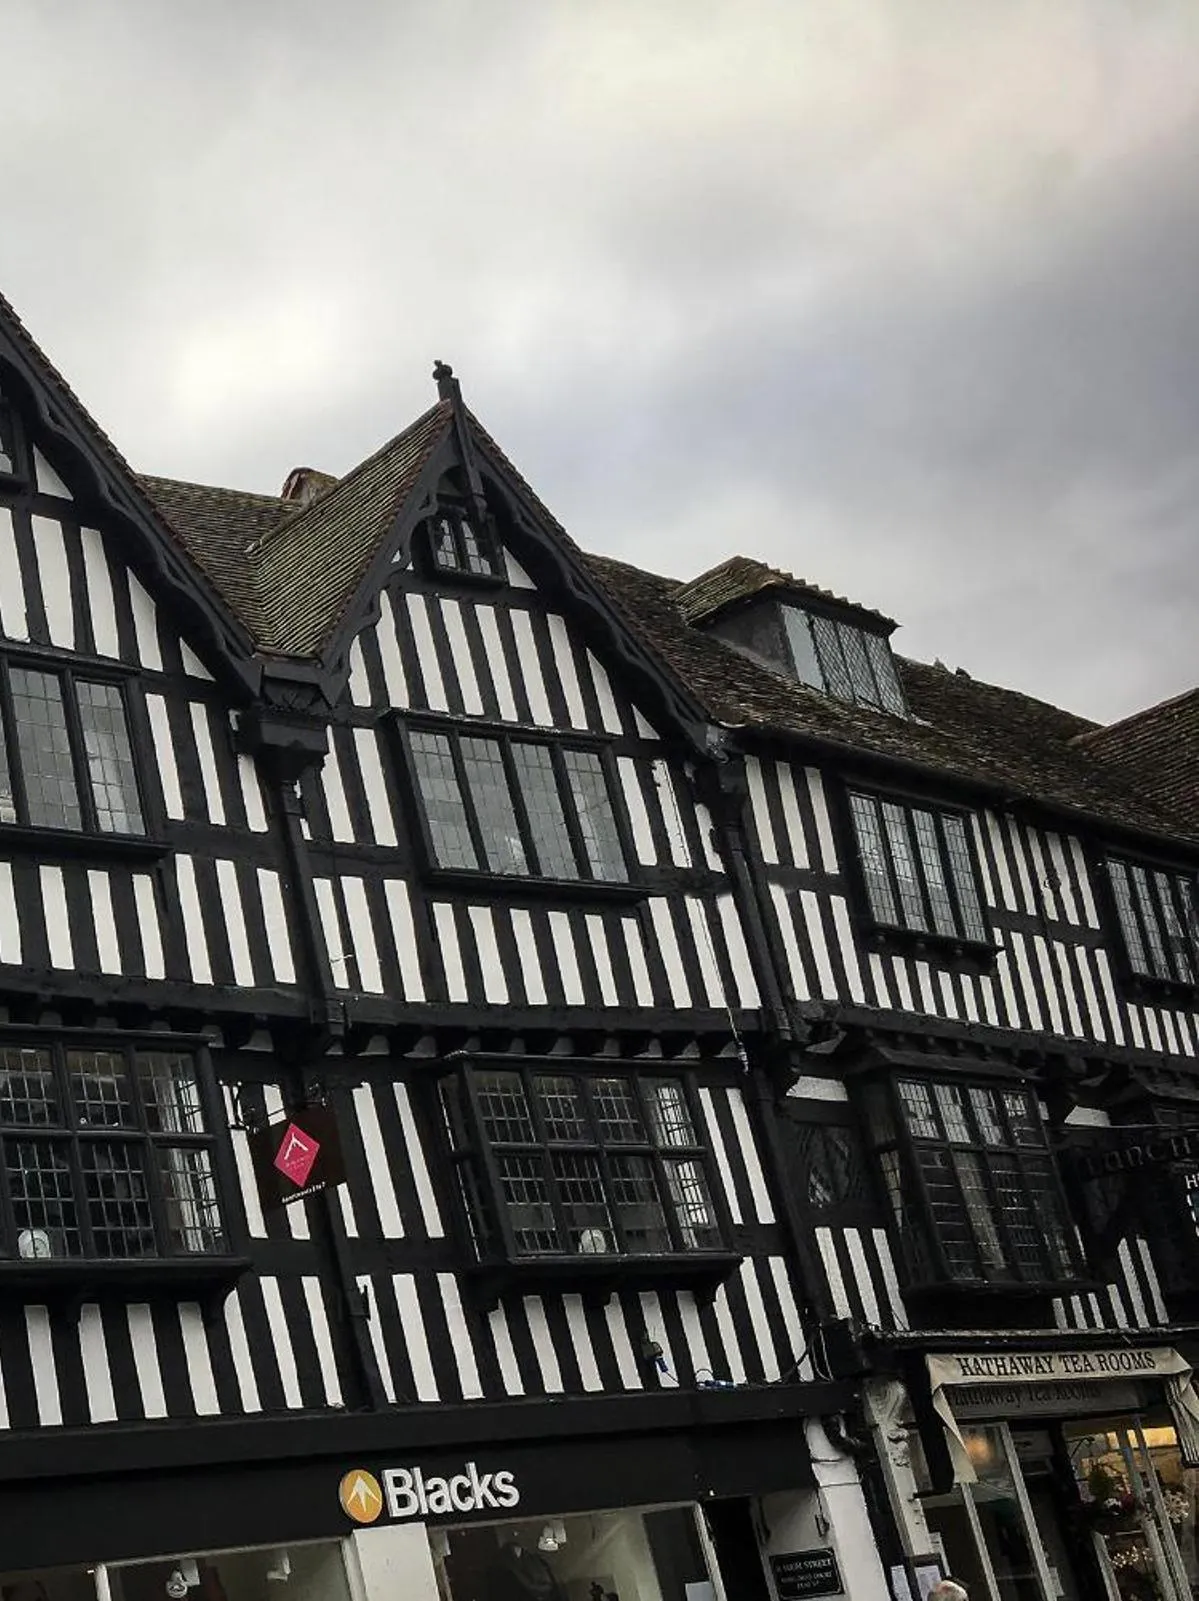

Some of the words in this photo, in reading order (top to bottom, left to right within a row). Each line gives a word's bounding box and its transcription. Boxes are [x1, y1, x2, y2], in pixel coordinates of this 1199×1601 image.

[956, 1356, 1055, 1376] HATHAWAY
[1058, 1354, 1096, 1373] TEA
[1095, 1351, 1156, 1371] ROOMS
[381, 1461, 520, 1518] Blacks
